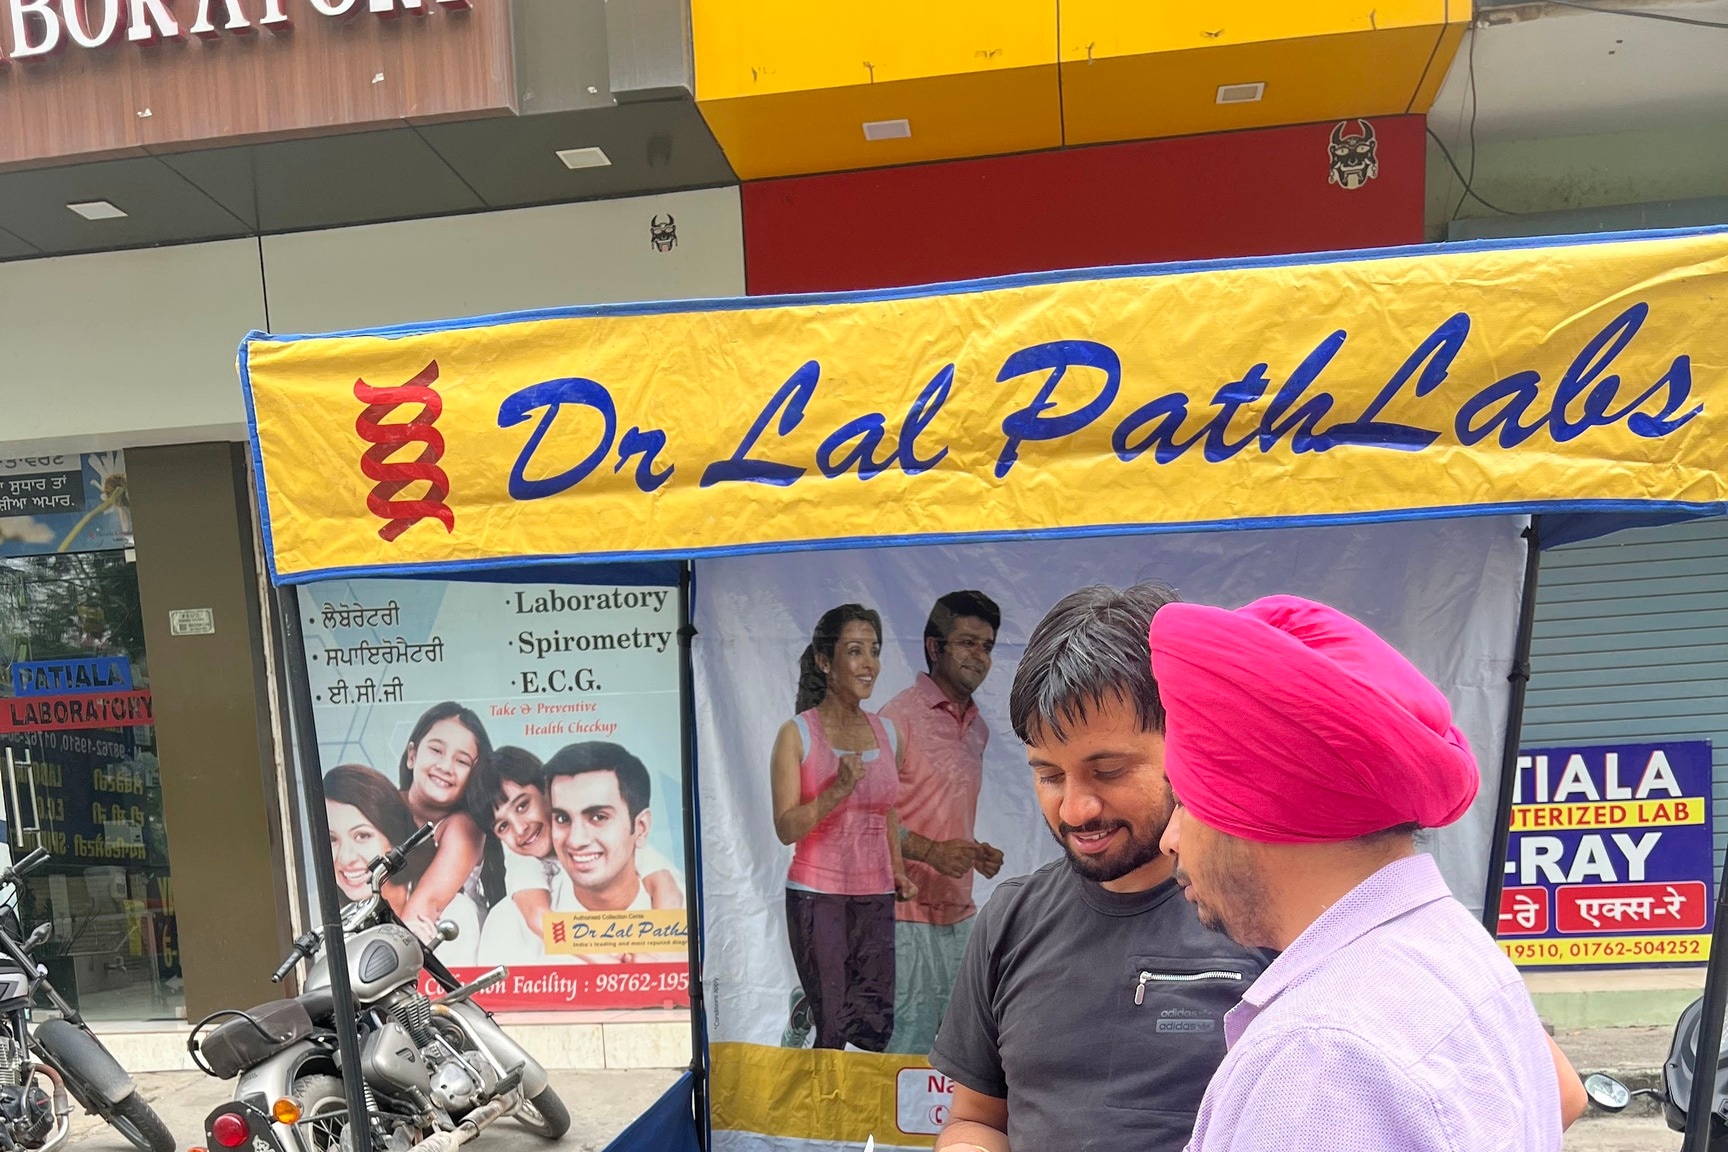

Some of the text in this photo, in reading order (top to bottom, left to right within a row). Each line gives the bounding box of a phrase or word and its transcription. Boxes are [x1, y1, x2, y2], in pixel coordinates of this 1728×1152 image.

[497, 302, 1704, 500] Dr Lal PathLabs
[515, 588, 668, 614] Laboratory
[518, 627, 672, 659] Spirometry
[19, 663, 124, 691] PATIALA
[520, 668, 602, 694] E.C.G.
[11, 695, 152, 726] LABORATORY
[490, 703, 516, 716] Take
[537, 701, 597, 714] Preventive
[525, 719, 617, 738] Health Checkup
[1512, 750, 1682, 803] TIALA
[1638, 802, 1690, 823] LAB
[1575, 886, 1687, 927] एक्स-रे
[572, 922, 597, 939] Dr
[600, 922, 634, 939] Lal
[1570, 940, 1700, 957] 01762-504252
[513, 971, 577, 1002] Facility
[1158, 1020, 1197, 1031] adidas
[1160, 1008, 1197, 1018] adidas
